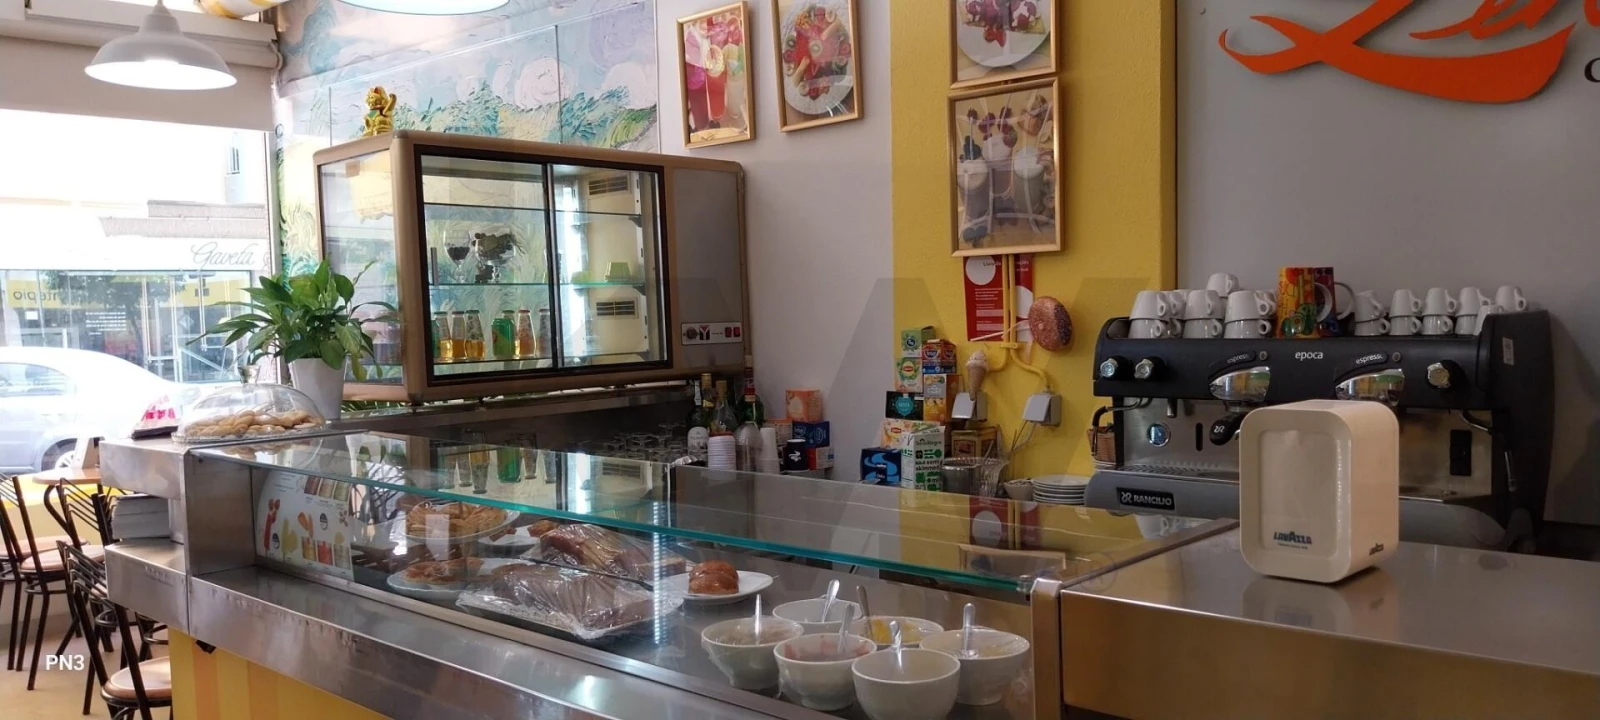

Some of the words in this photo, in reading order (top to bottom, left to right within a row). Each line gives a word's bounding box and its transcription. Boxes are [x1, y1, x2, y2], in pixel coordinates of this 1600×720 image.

[191, 242, 259, 272] Gaveta
[1294, 351, 1324, 362] epoca
[1133, 494, 1172, 506] RANCILIO
